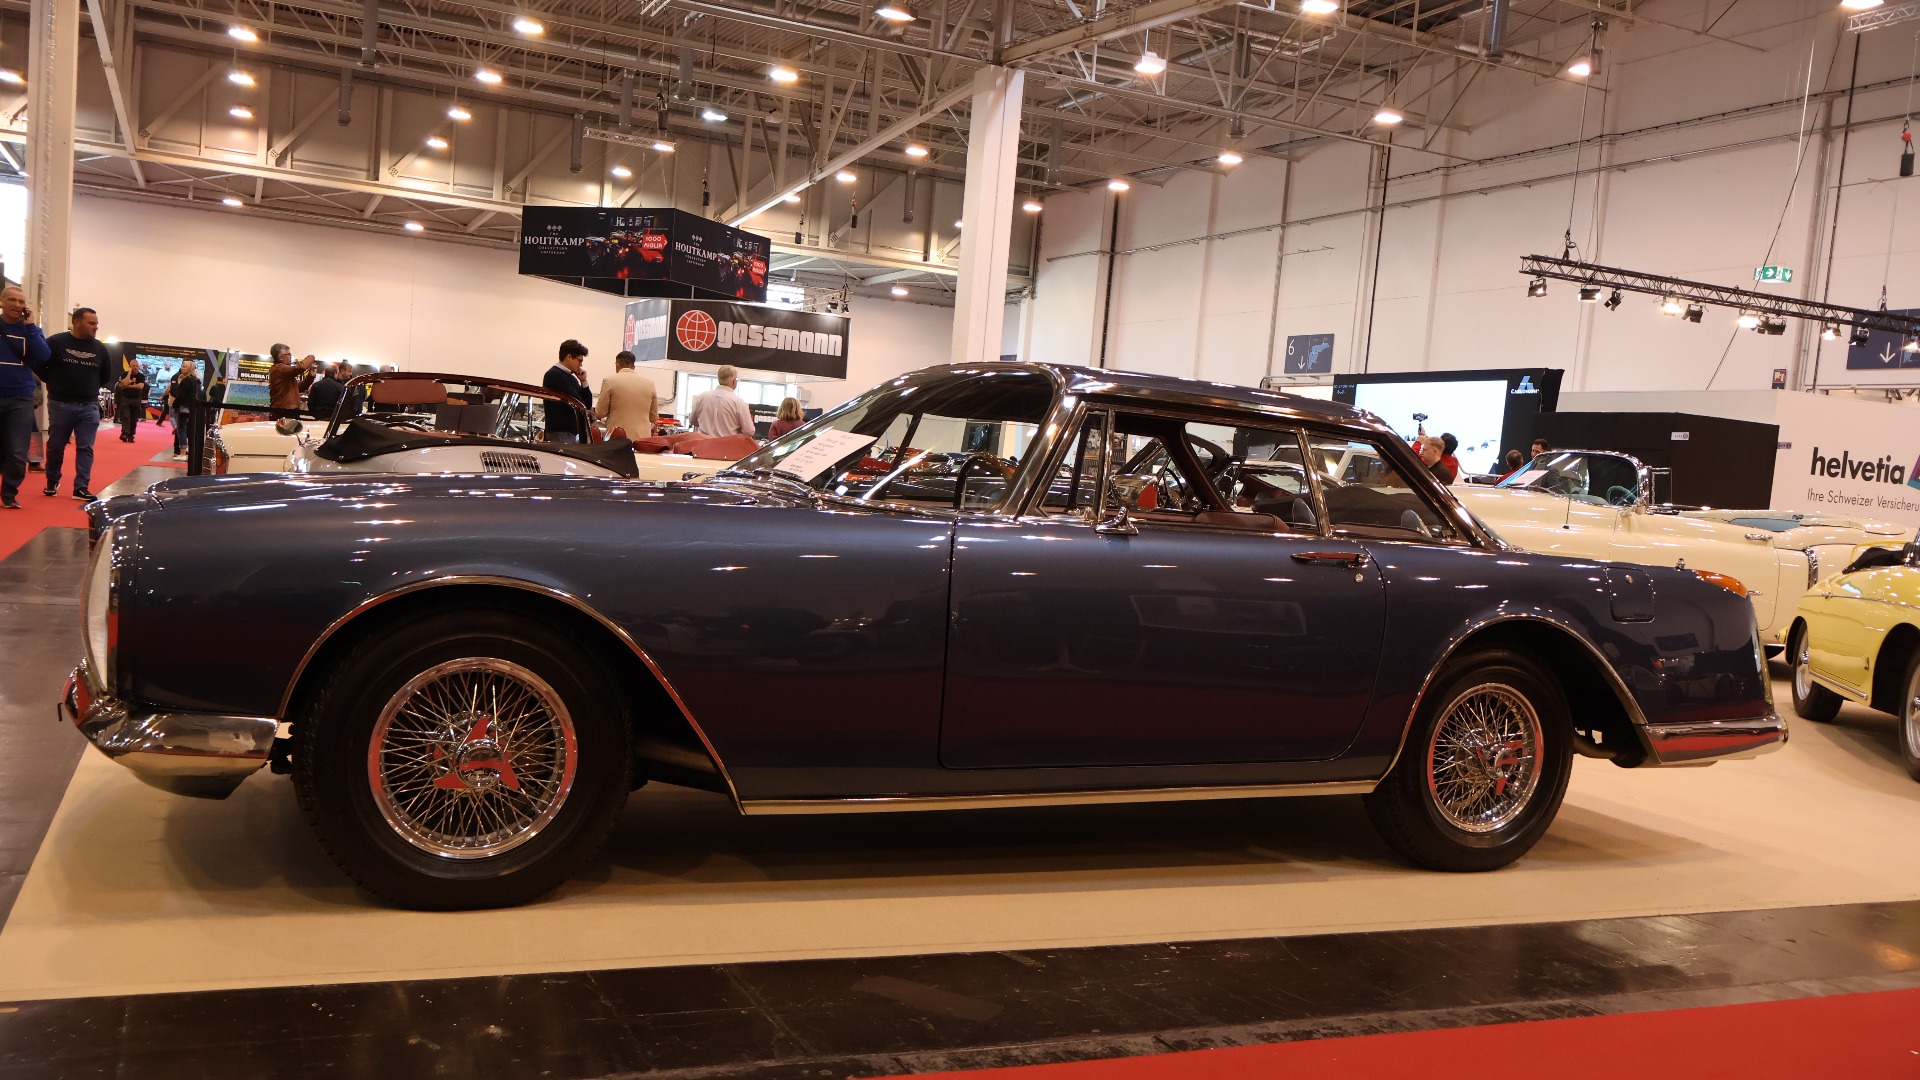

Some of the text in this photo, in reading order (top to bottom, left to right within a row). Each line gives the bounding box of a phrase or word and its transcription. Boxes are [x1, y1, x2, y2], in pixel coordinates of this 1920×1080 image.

[524, 236, 585, 246] HOUTKAMP
[675, 241, 718, 261] HOUTKAMP
[717, 321, 843, 357] gassmann
[1288, 339, 1295, 356] 6
[1810, 446, 1905, 485] helvetia
[1807, 488, 1920, 512] Ihre Schweizer Versicheru
